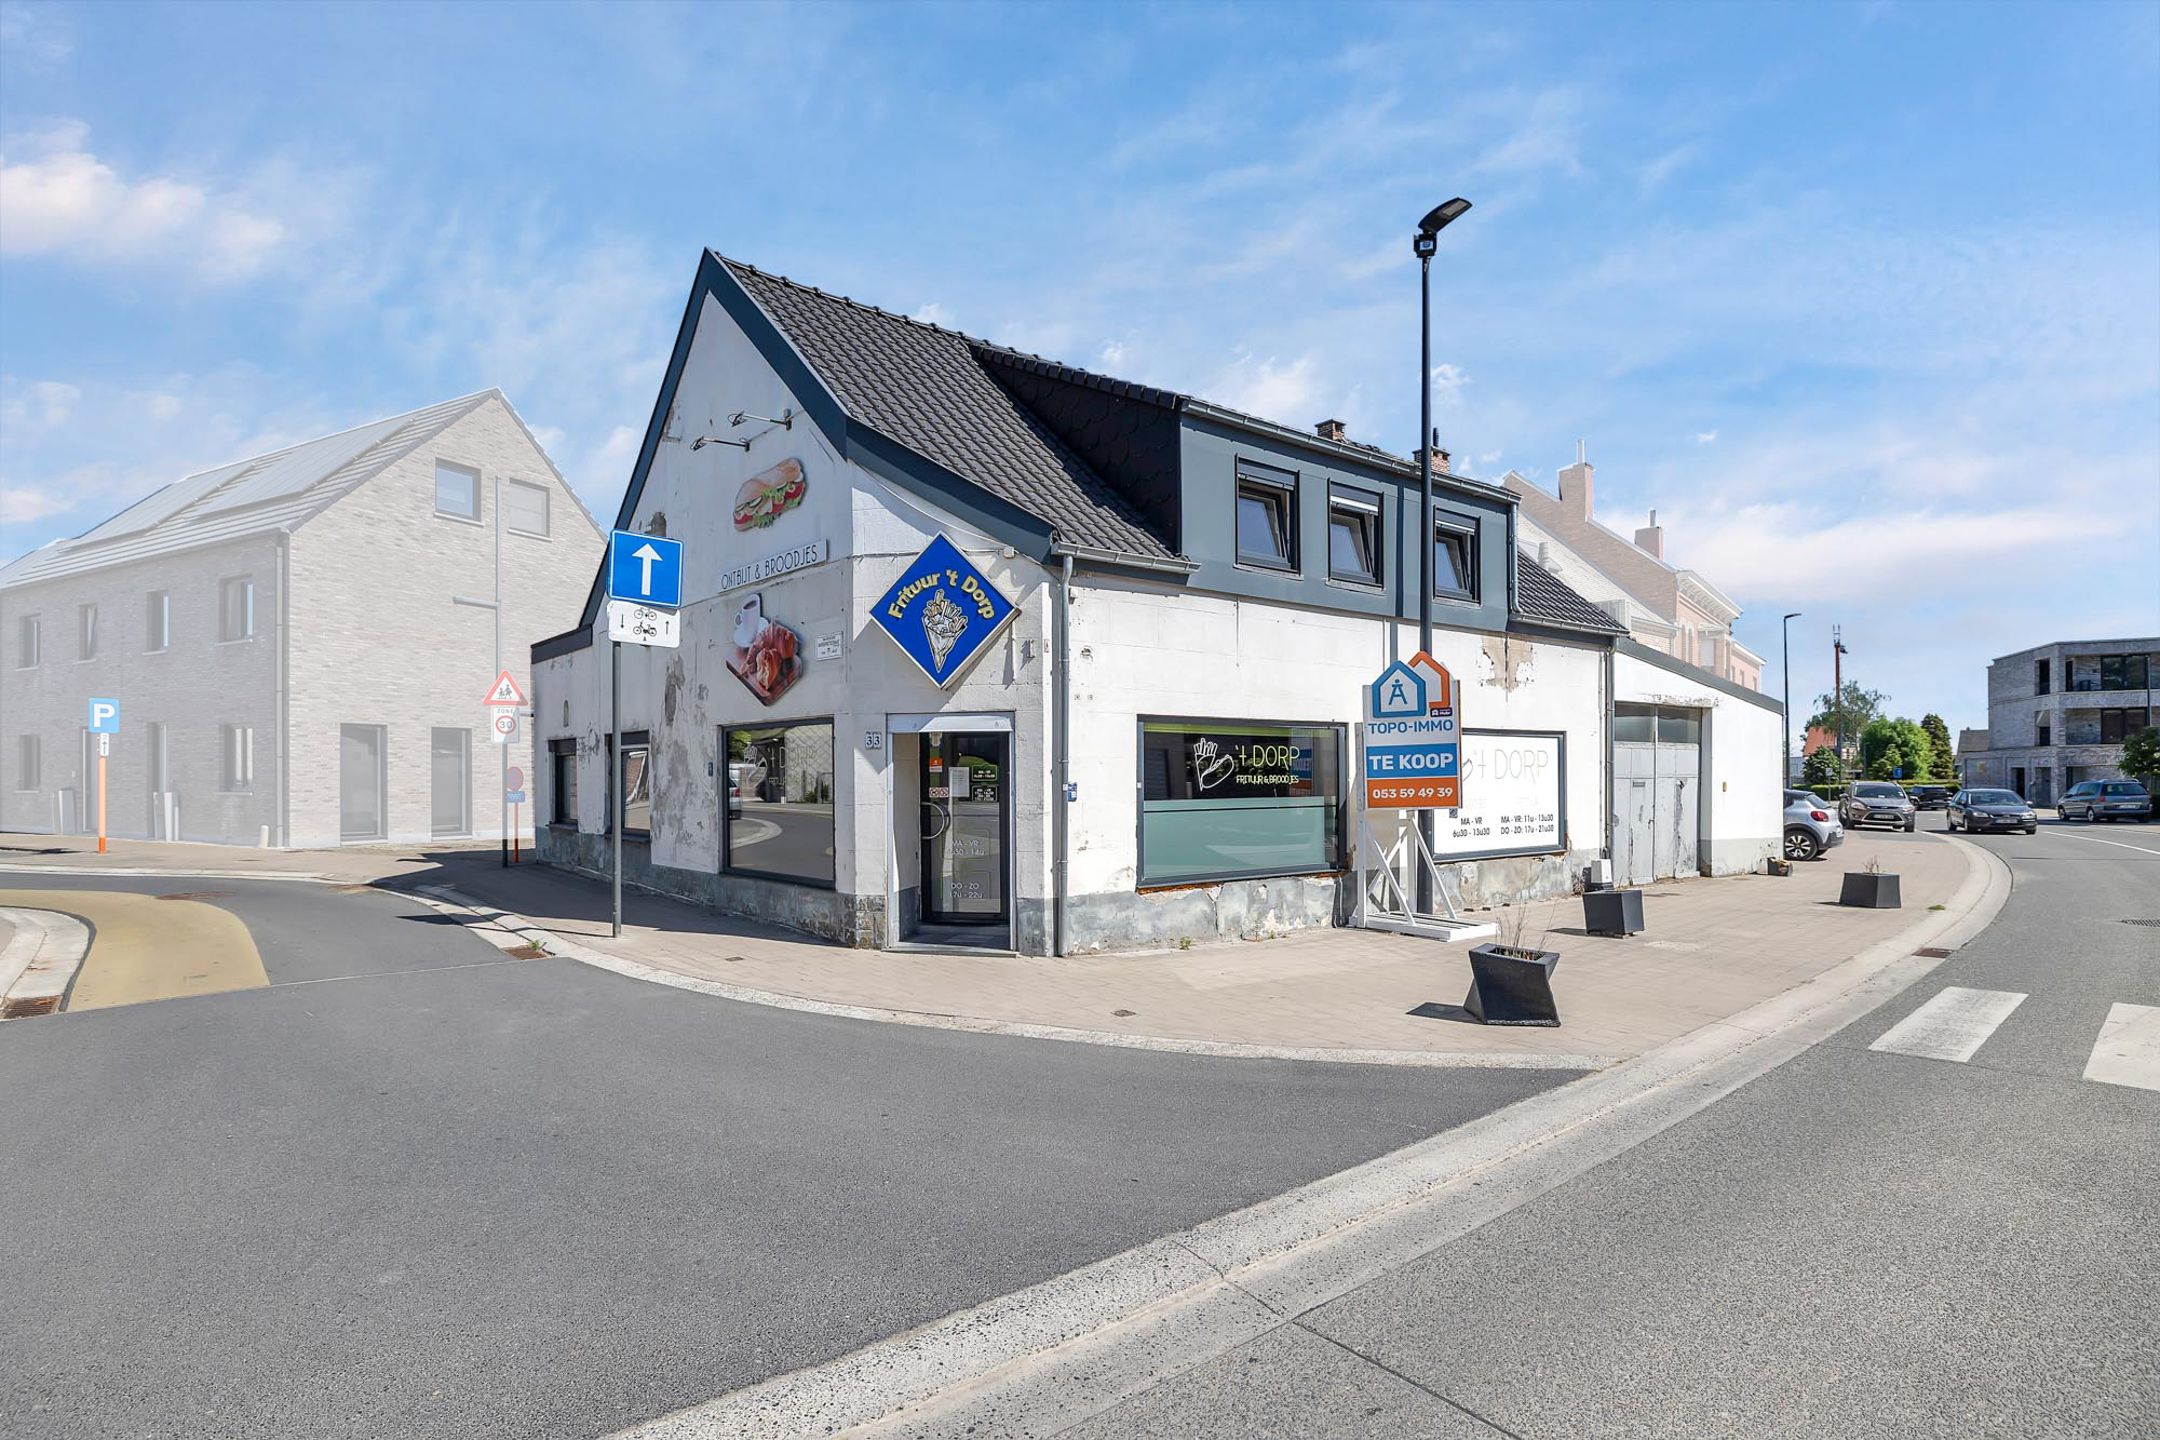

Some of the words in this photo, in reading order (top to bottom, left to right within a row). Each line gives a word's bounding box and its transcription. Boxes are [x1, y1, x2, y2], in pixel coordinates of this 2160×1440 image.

[721, 565, 751, 589] ONTBIJT
[755, 563, 761, 580] &
[766, 545, 817, 577] BROODJES
[888, 572, 941, 618] Frituur
[946, 569, 958, 586] 't
[961, 575, 995, 619] Dorp
[94, 703, 115, 728] P
[500, 720, 513, 729] 30
[1368, 719, 1453, 735] TOPO-IMMO
[1253, 745, 1300, 770] DORP
[1369, 754, 1394, 771] TE
[1399, 752, 1454, 770] KOOP
[1494, 748, 1549, 784] DORP
[1373, 788, 1397, 799] 053
[1400, 788, 1415, 798] 59
[1418, 787, 1434, 798] 49
[1437, 787, 1453, 798] 39
